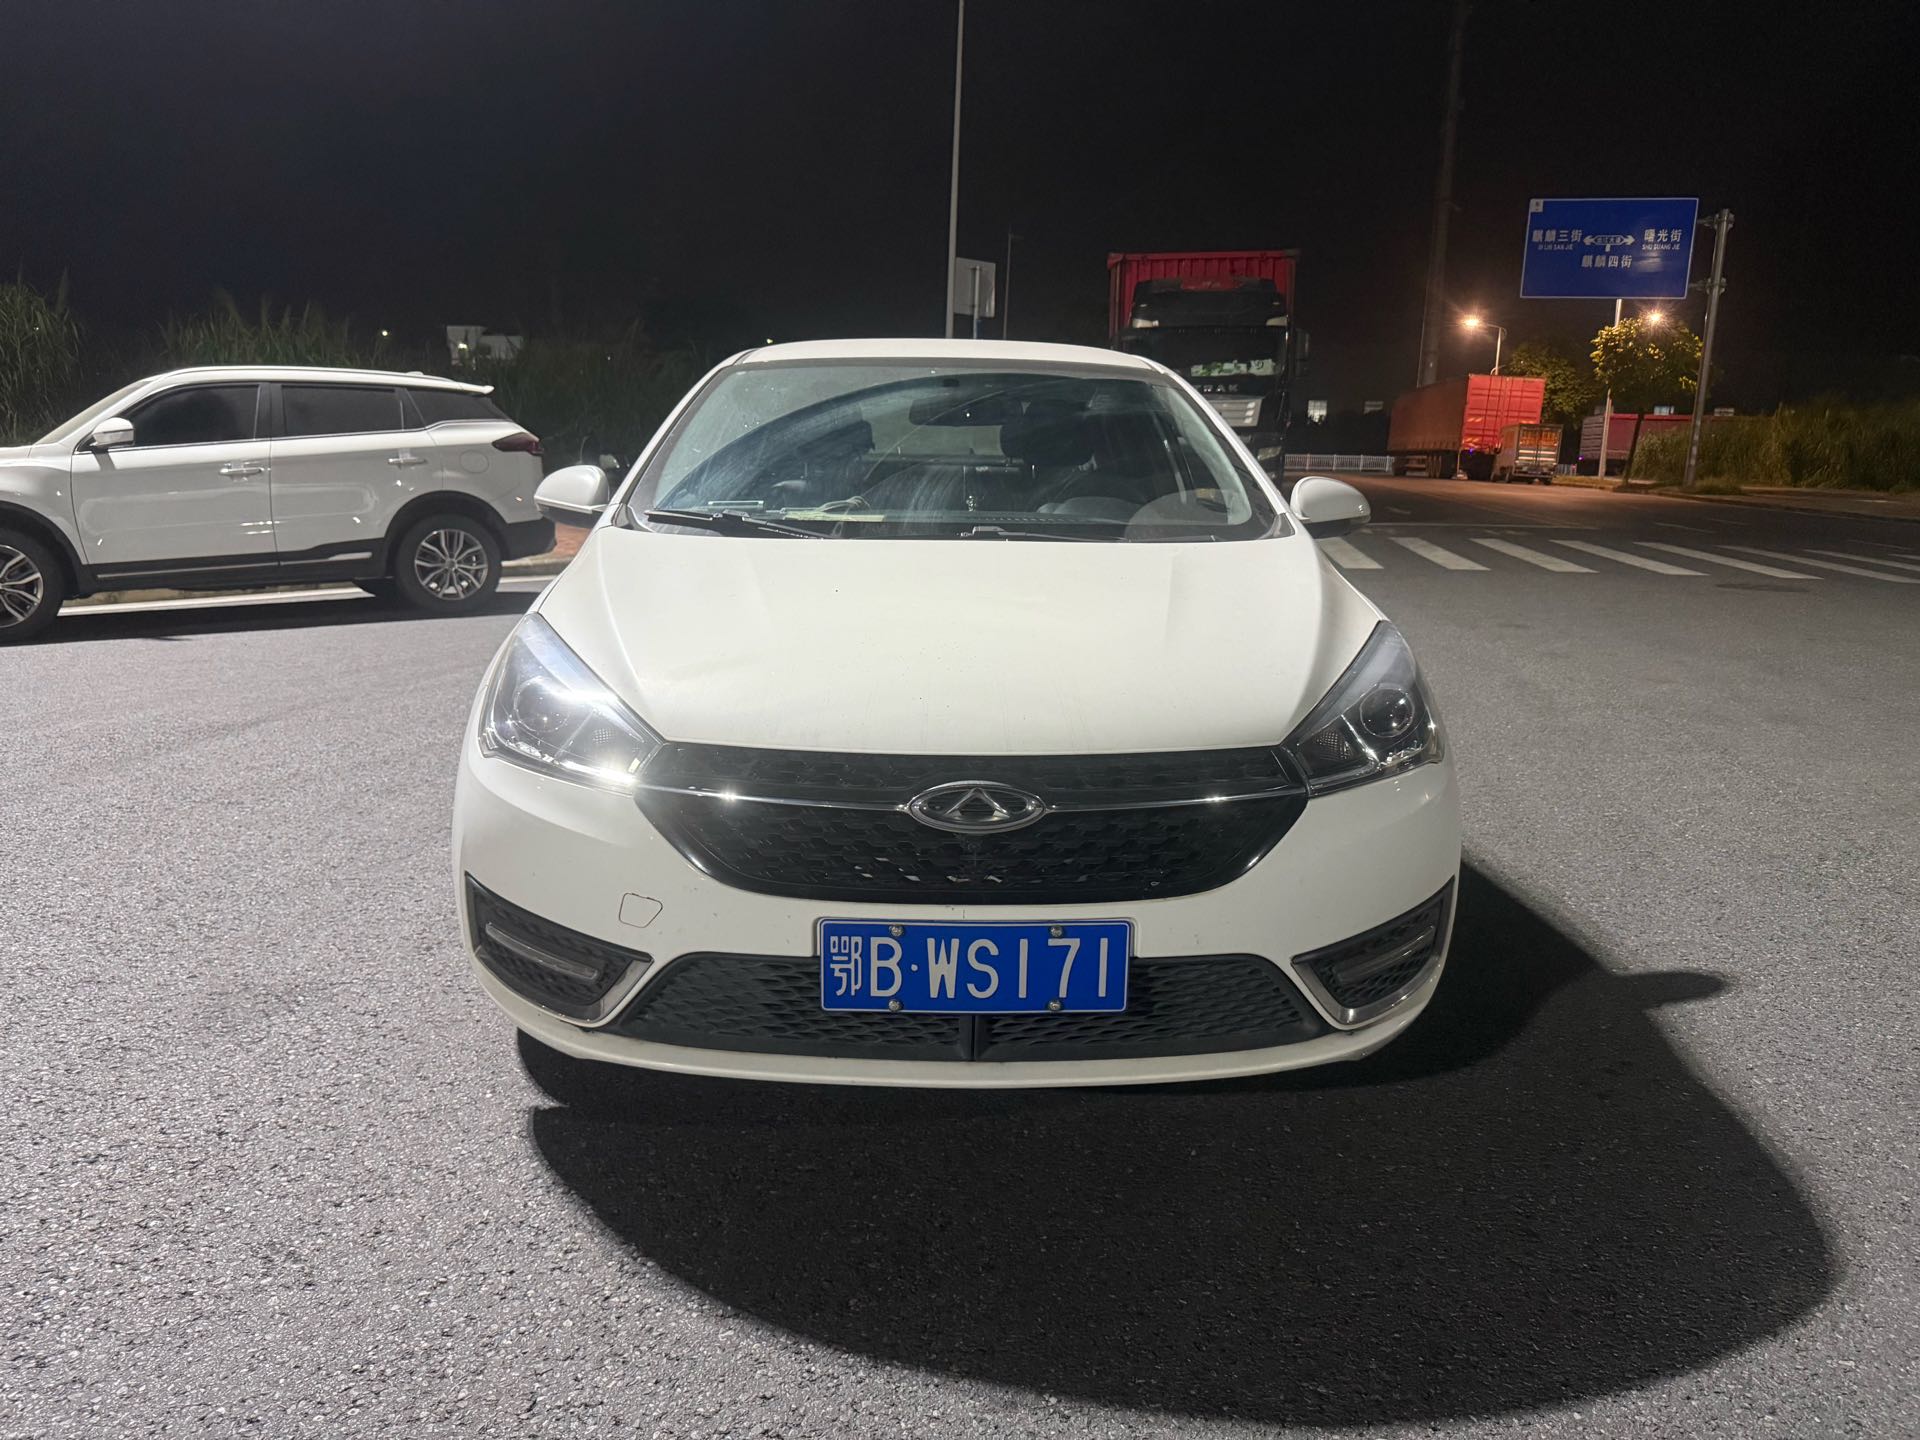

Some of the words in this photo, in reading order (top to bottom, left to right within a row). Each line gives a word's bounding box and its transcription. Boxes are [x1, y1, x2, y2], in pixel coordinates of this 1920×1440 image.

[1643, 228, 1682, 242] 曙光街
[829, 935, 1109, 999] 鄂B·WS171
